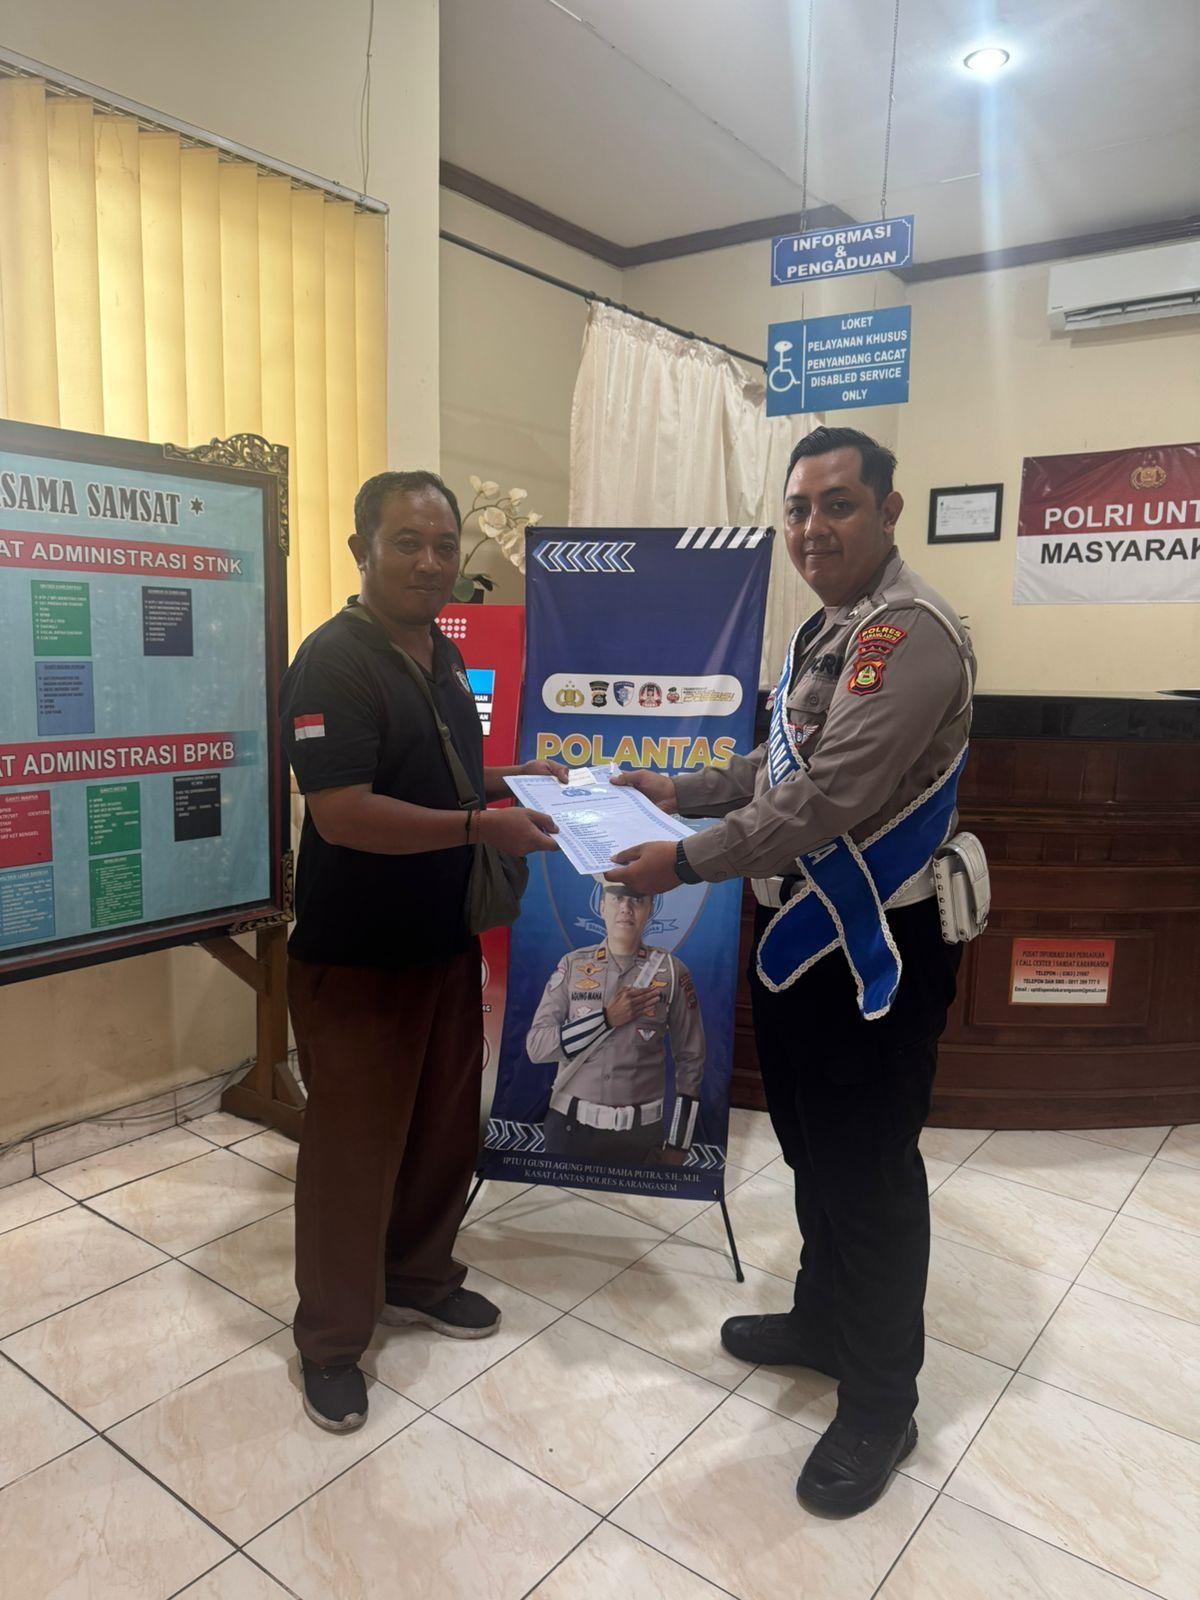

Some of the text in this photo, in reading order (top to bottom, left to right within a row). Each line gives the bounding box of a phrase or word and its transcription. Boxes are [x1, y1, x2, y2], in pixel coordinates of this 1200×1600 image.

[793, 225, 892, 252] INFORMASI
[835, 245, 847, 259] &
[787, 251, 897, 278] PENGADUAN
[841, 316, 874, 330] LOKET
[808, 330, 908, 352] PELAYANAN KHUSUS
[807, 349, 907, 370] PENYANDANG CACAT
[811, 367, 901, 388] DISABLED SERVICE
[842, 389, 868, 402] ONLY
[0, 472, 180, 525] SAMA SAMSAT
[1044, 503, 1133, 530] POLRI
[31, 543, 187, 570] ADMINISTRASI
[193, 555, 242, 575] STNK
[862, 626, 902, 637] POLRES
[0, 741, 235, 778] T ADMINISTRASI BPKB
[536, 732, 736, 769] POLANTAS
[528, 1159, 552, 1168] GUSTI
[552, 1161, 583, 1172] AGUNG
[584, 1164, 607, 1174] PUTU
[607, 1167, 633, 1178] MAHA
[524, 1169, 678, 1191] KASAT LANTAS POLRES KARANGASEM
